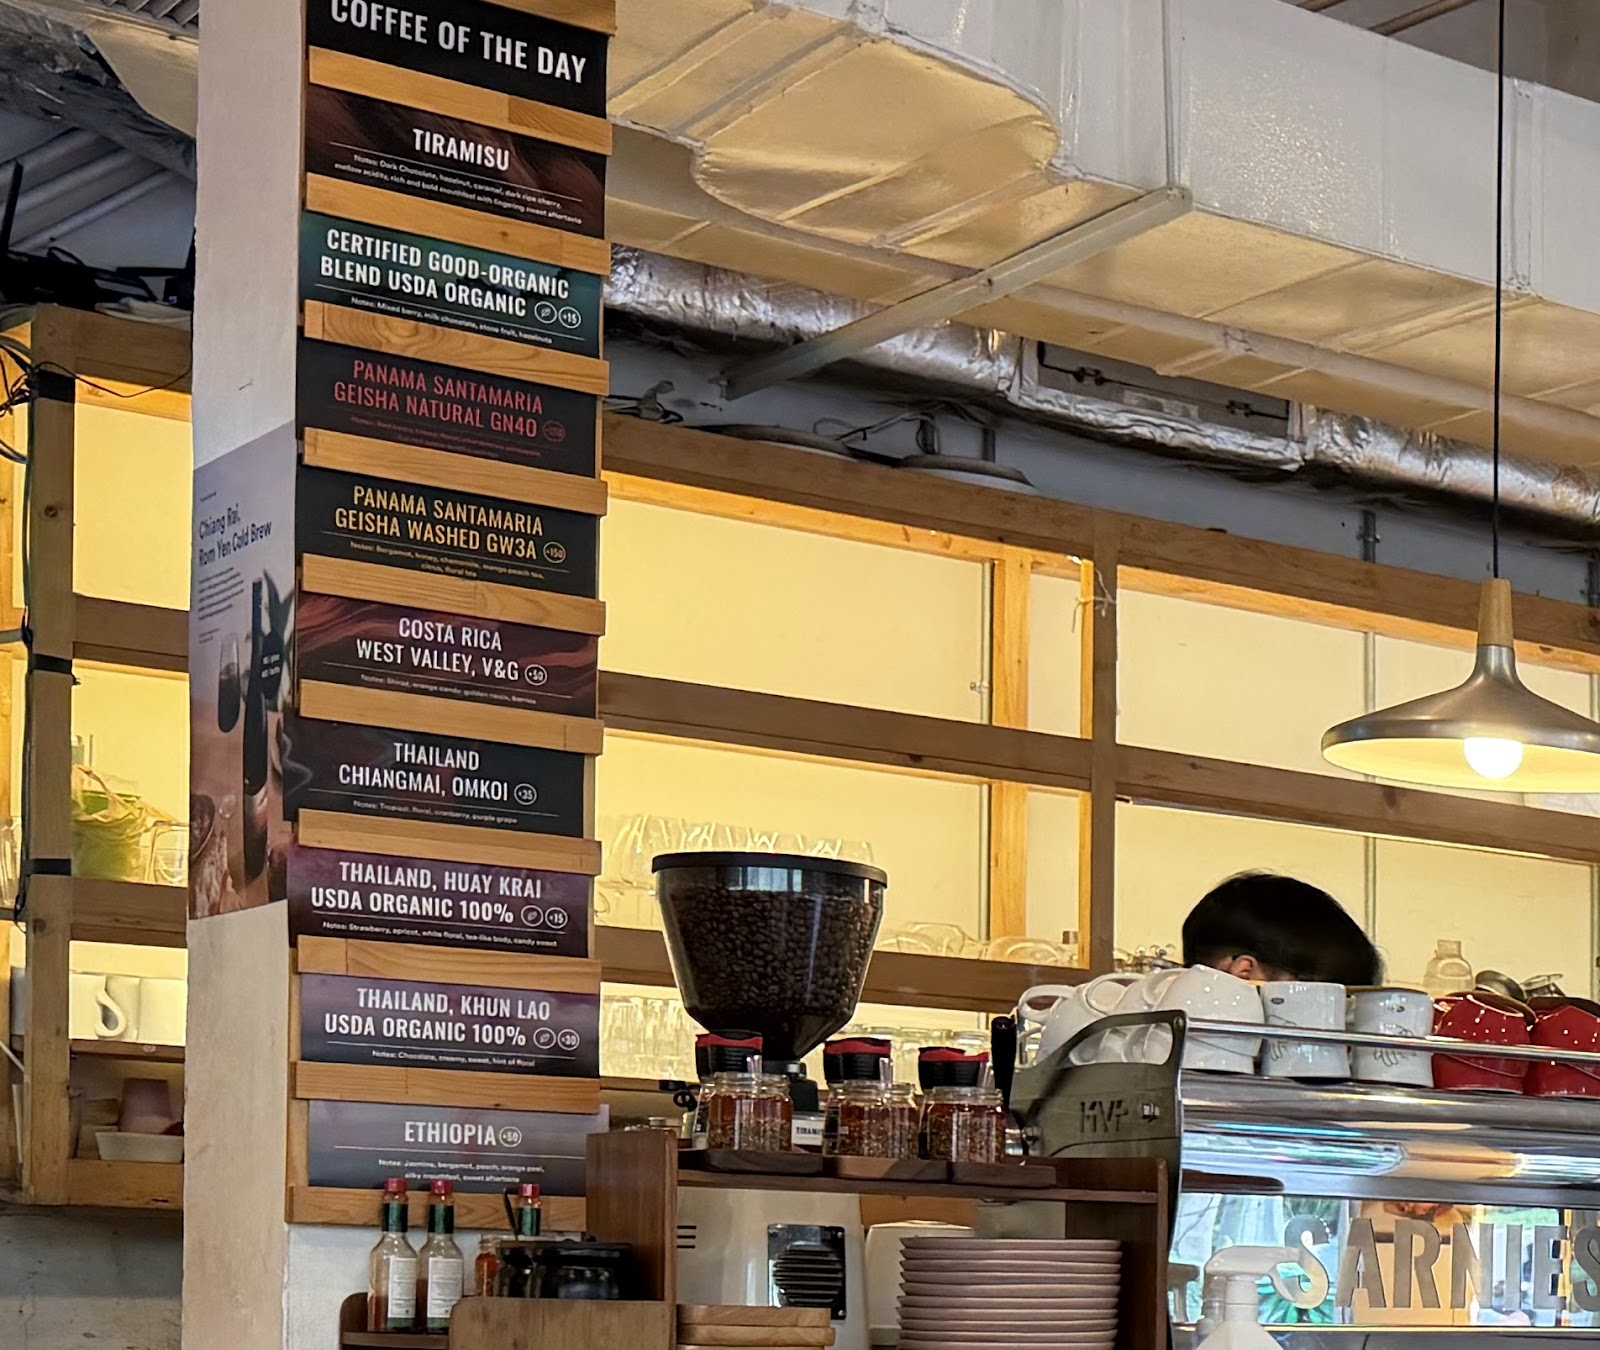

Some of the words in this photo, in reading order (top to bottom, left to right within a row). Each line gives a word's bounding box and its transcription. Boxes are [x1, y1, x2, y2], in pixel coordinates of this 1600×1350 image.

[330, 0, 428, 44] COFFEE
[438, 21, 471, 53] OF
[480, 31, 527, 70] THE
[538, 46, 587, 83] DAY
[412, 128, 511, 171] TIRAMISU
[327, 229, 421, 267] CERTIFIED
[428, 251, 569, 299] GOOD-ORGANIC
[321, 256, 380, 286] BLEND
[388, 270, 438, 299] USDA
[444, 282, 526, 317] ORGANIC
[353, 359, 427, 392] PANAMA
[433, 376, 543, 414] SANTAMARIA
[334, 381, 400, 411] GEISHA
[406, 395, 484, 428] NATURAL
[490, 411, 537, 437] GN40
[200, 514, 225, 539] Chiang
[353, 485, 427, 517] PANAMA
[433, 500, 543, 536] SANTAMARIA
[217, 535, 231, 559] Yen
[233, 526, 249, 552] Cold
[251, 522, 272, 543] Brew
[335, 507, 400, 537] GEISHA
[407, 519, 480, 550] WASHED
[486, 533, 537, 560] GW3A
[399, 617, 455, 644] COSTA
[461, 626, 502, 651] RICA
[356, 638, 404, 664] WEST
[411, 646, 476, 676] VALLEY,
[482, 657, 519, 681] V&G
[393, 742, 480, 771] THAILAND
[338, 764, 446, 797] CHIANGMAI,
[452, 776, 508, 801] OMKOI
[339, 861, 437, 892] THAILAND,
[444, 871, 492, 894] HUAY
[499, 875, 542, 898] KRAI
[311, 887, 363, 910] USDA
[369, 892, 453, 918] ORGANIC
[459, 900, 514, 924] 100%
[357, 987, 454, 1016] THAILAND,
[460, 995, 511, 1018] KHUN
[517, 999, 550, 1020] LAO
[325, 1013, 376, 1036] USDA
[382, 1017, 465, 1042] ORGANIC
[472, 1023, 527, 1046] 100%
[404, 1120, 497, 1146] ETHIOPIA
